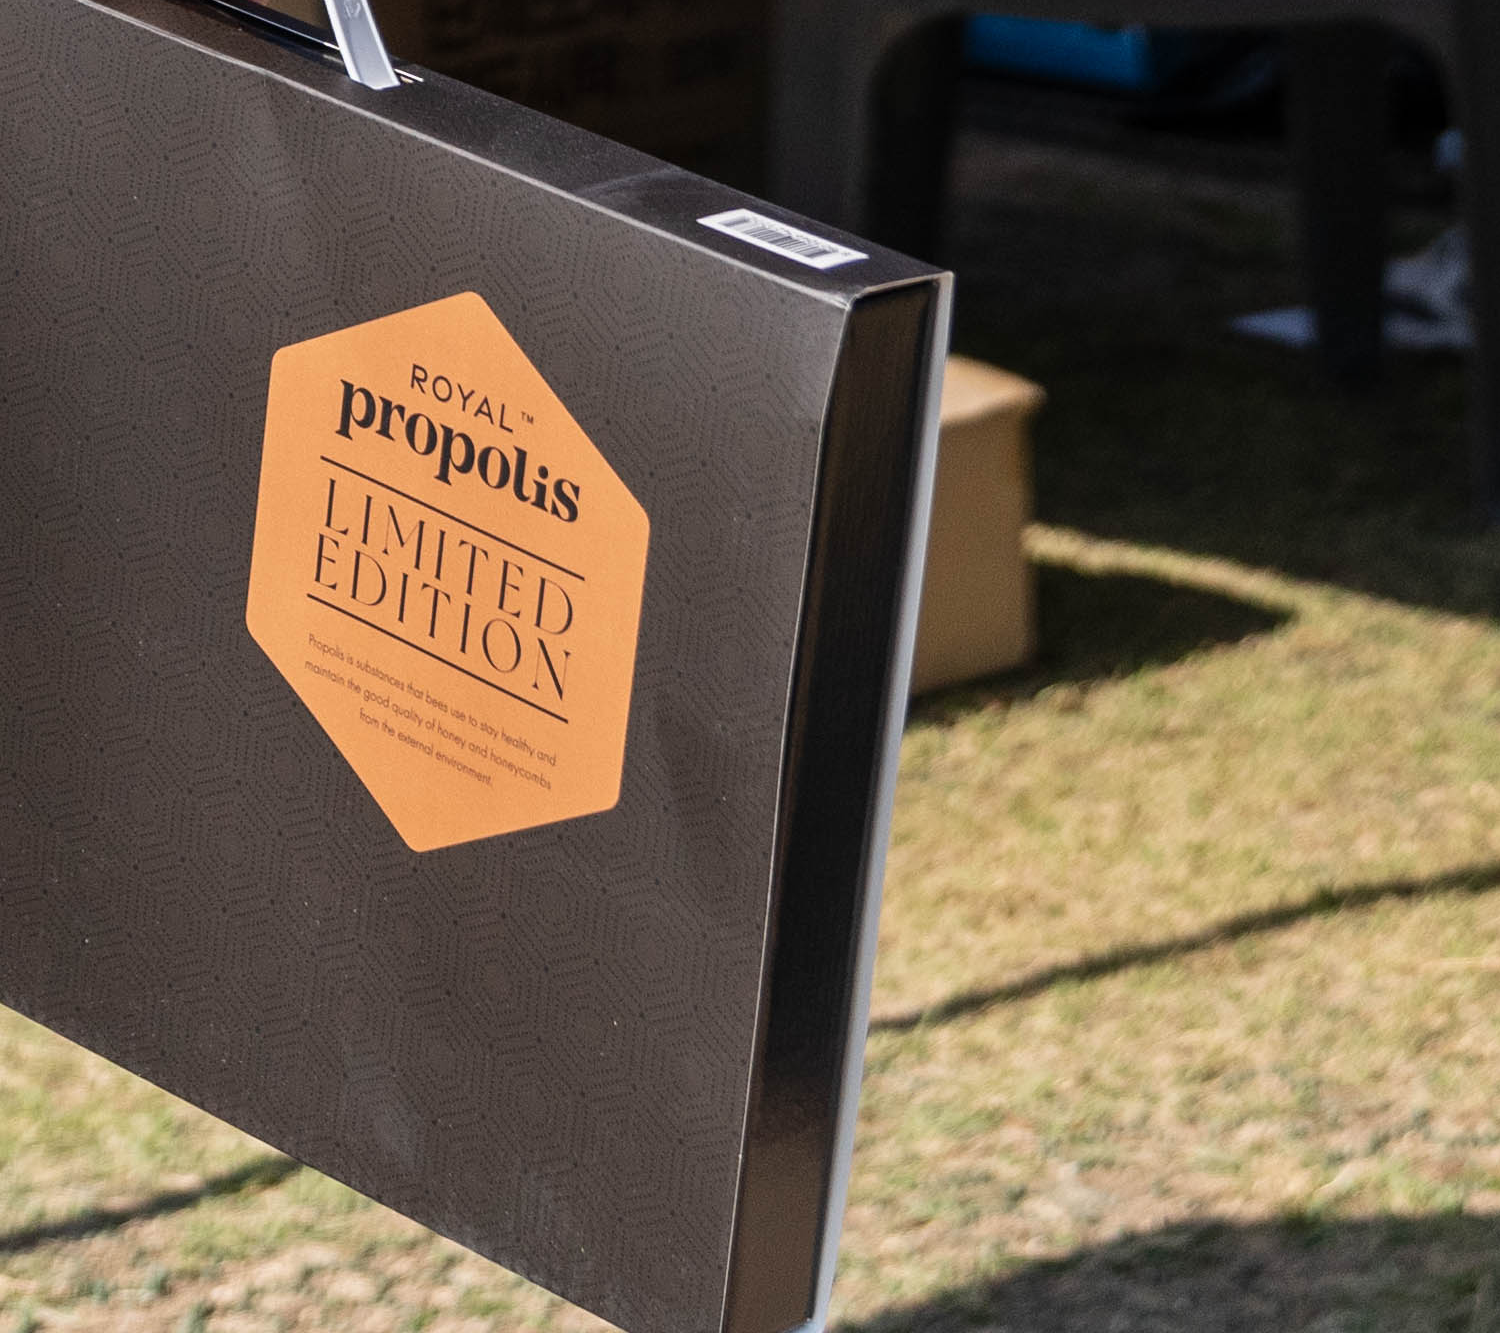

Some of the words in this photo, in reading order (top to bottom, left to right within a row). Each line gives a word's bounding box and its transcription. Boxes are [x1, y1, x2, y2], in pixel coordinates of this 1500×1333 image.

[335, 379, 581, 523] propolis
[410, 363, 514, 433] ROYAL
[314, 533, 572, 701] EDITION
[325, 478, 575, 635] LIMITED
[304, 660, 345, 686] maintain
[347, 678, 361, 694] the
[363, 689, 390, 709] good
[391, 703, 423, 727] quality
[425, 718, 436, 731] of
[438, 720, 466, 749] honey
[468, 744, 488, 759] and
[490, 748, 552, 790] honeycombs
[308, 633, 345, 661] Propolis
[356, 659, 405, 691] substances
[407, 672, 423, 699] that
[425, 690, 448, 713] bees
[450, 708, 466, 721] use
[468, 714, 477, 727] to
[480, 721, 499, 739] stay
[501, 727, 535, 757] healthy
[537, 751, 557, 767] and
[360, 707, 380, 729] from
[382, 720, 395, 737] the
[397, 732, 434, 757] external
